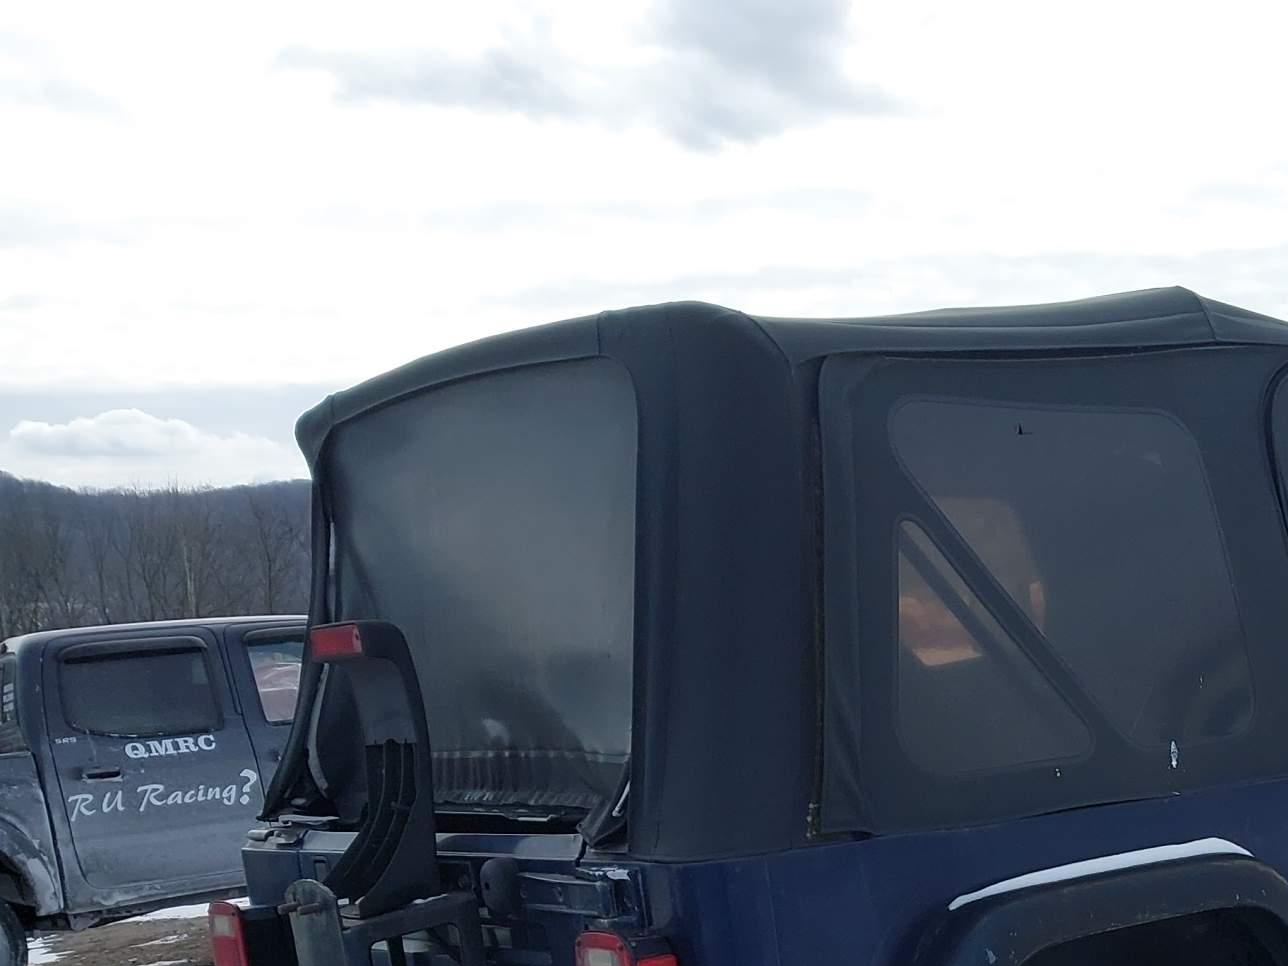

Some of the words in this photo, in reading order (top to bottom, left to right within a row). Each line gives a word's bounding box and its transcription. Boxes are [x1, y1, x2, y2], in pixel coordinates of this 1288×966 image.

[124, 734, 217, 759] QMRC
[68, 793, 96, 821] R
[102, 790, 125, 813] U
[137, 768, 257, 812] Racing?
